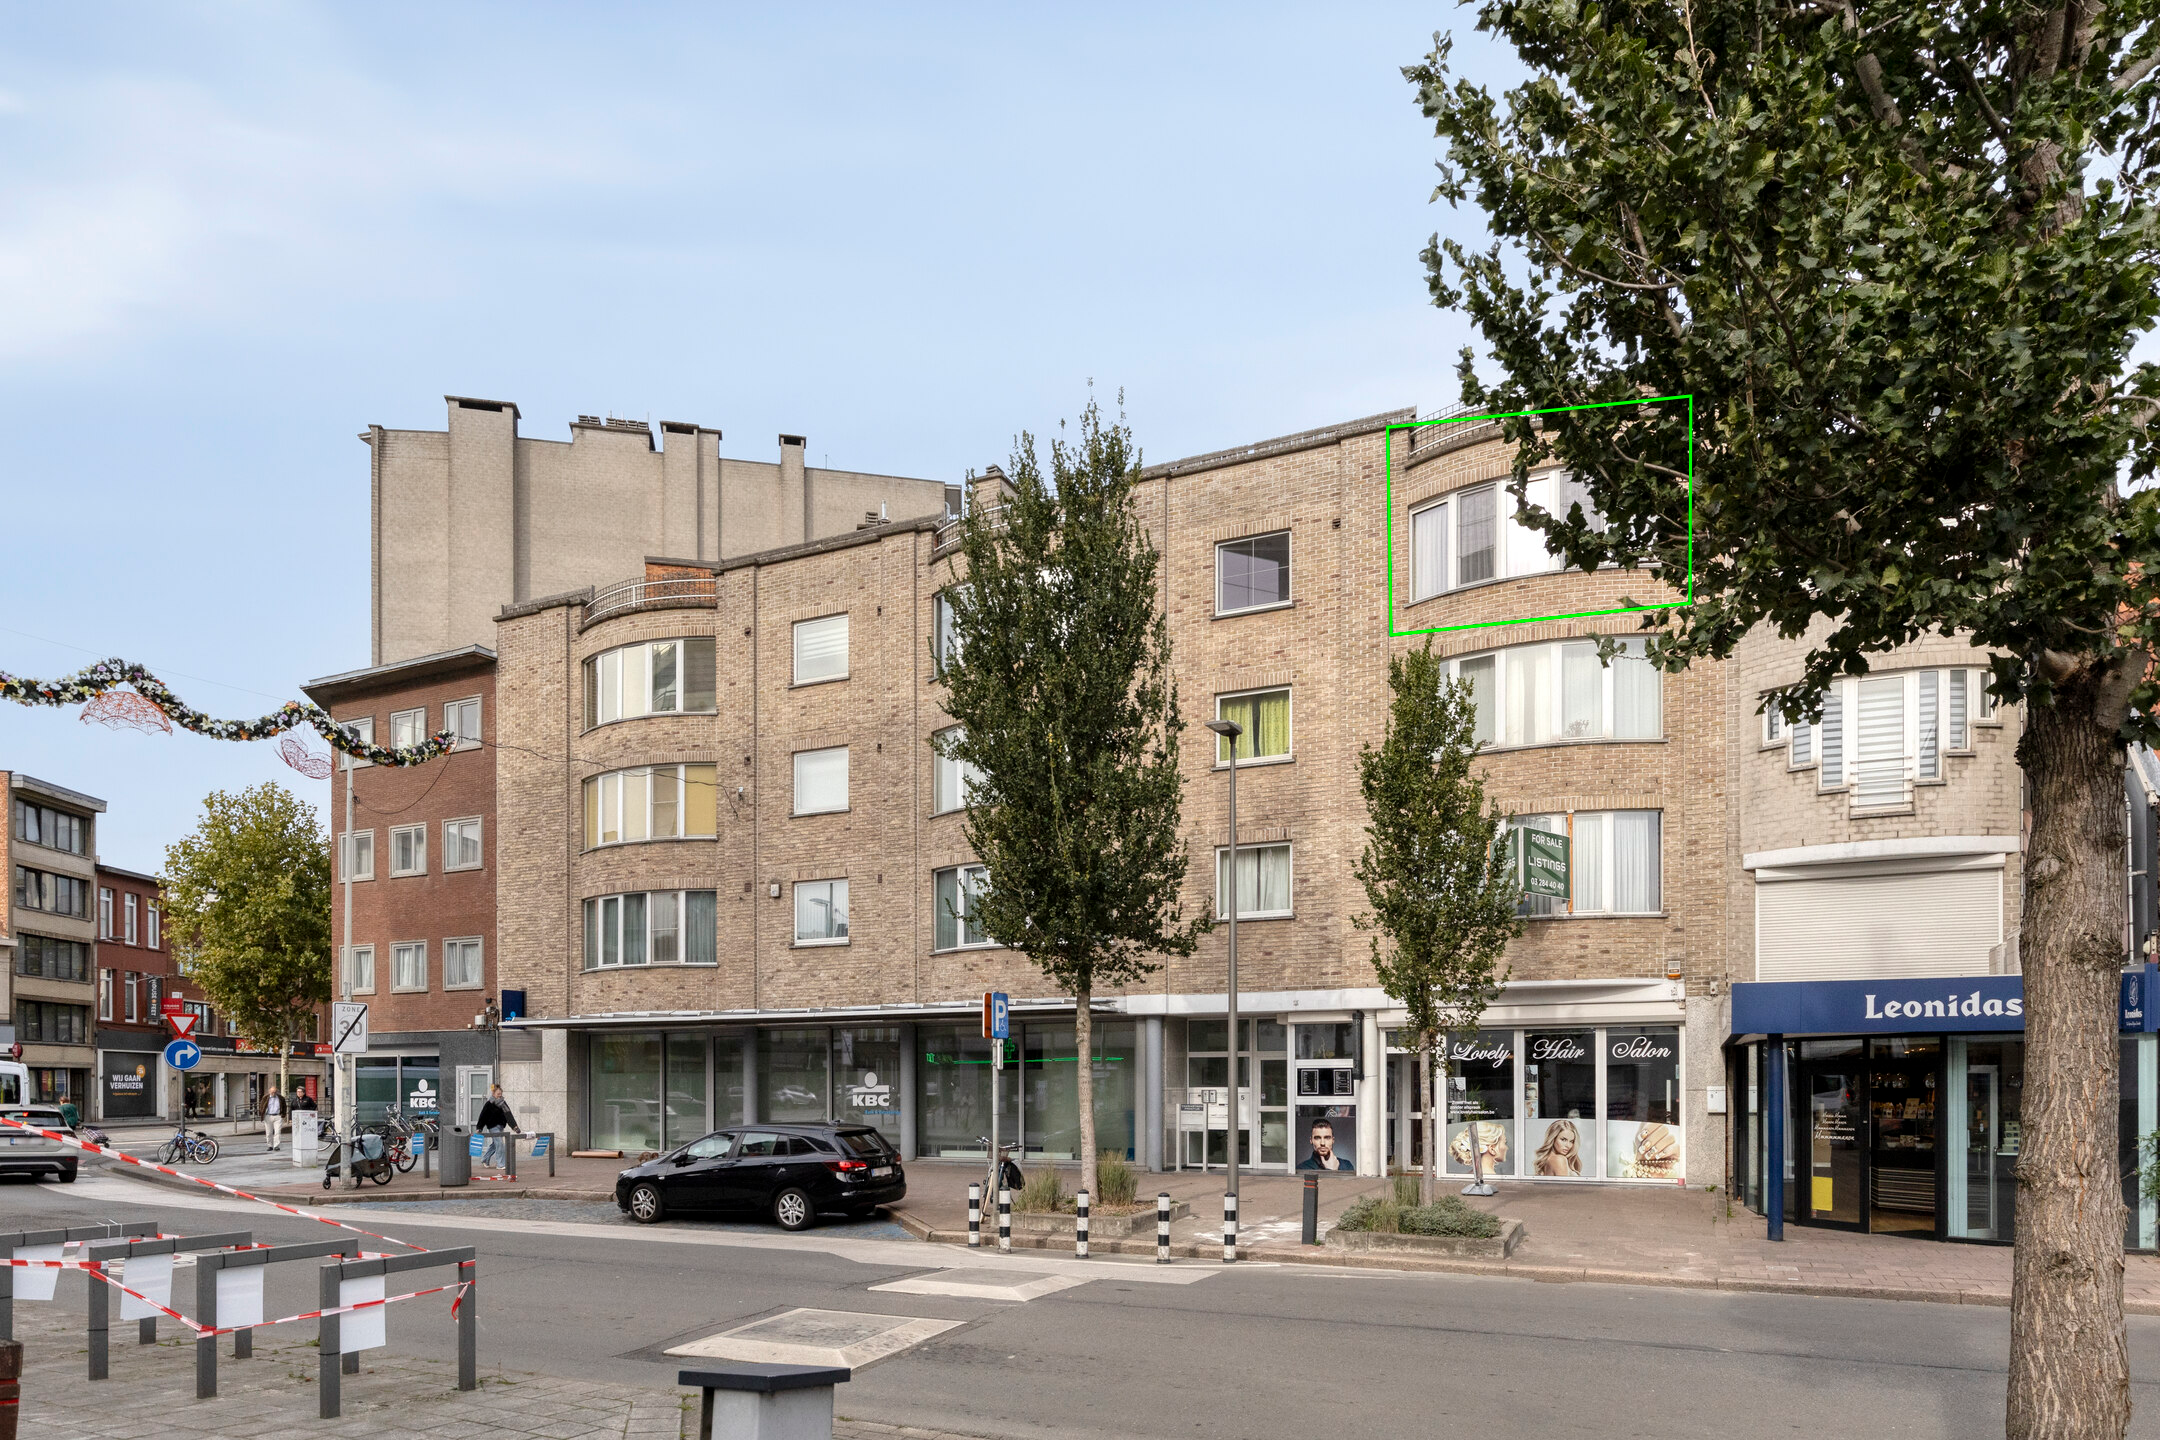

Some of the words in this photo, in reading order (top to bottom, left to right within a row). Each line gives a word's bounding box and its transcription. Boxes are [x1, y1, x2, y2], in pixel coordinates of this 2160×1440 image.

[1532, 834, 1546, 845] FOR
[1546, 838, 1562, 848] SALE
[1530, 878, 1538, 886] 03
[1538, 879, 1548, 887] 284
[1549, 880, 1556, 889] 40
[1557, 882, 1564, 890] 40
[1864, 990, 2024, 1019] Leonidas
[995, 1000, 1006, 1032] P
[339, 1020, 363, 1036] 30
[1449, 1039, 1511, 1068] Lovely
[1532, 1038, 1585, 1060] Hair
[1612, 1036, 1672, 1058] Salon
[410, 1098, 436, 1108] KBC
[852, 1094, 890, 1106] KBC
